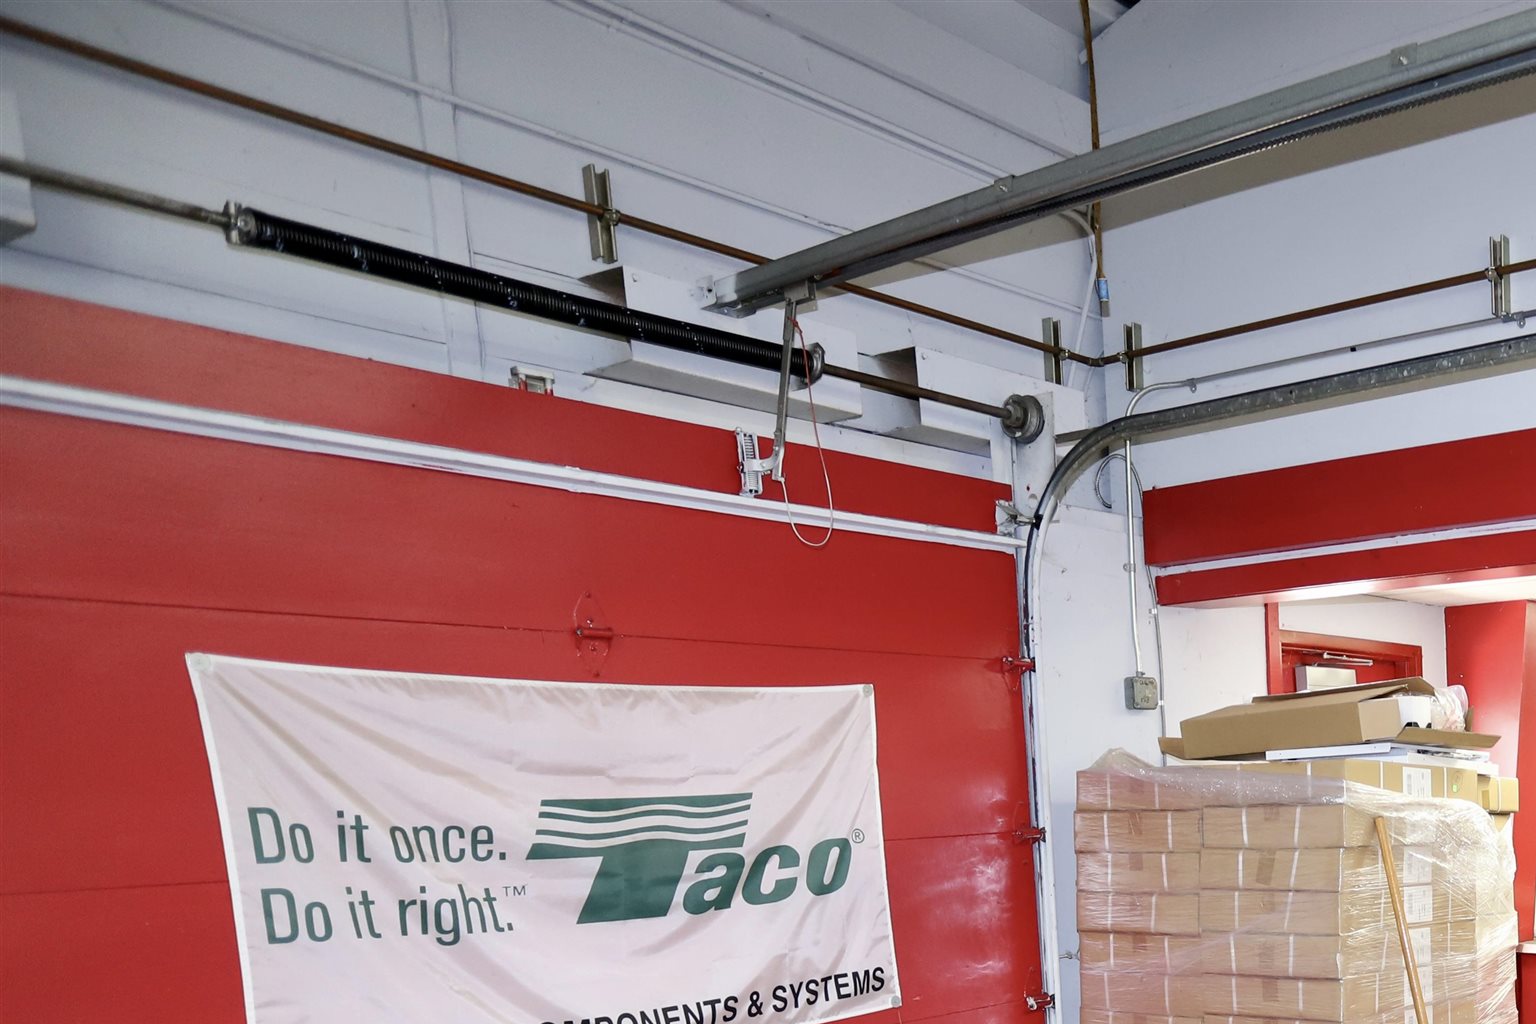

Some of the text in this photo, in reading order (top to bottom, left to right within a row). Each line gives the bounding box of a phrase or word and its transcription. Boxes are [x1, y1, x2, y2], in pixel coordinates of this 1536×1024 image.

[248, 806, 507, 865] Do it once.
[526, 792, 853, 925] Taco
[260, 887, 333, 945] Do
[345, 887, 382, 939] it
[398, 886, 514, 946] right.
[746, 989, 764, 1018] &
[771, 966, 886, 1014] SYSTEMS
